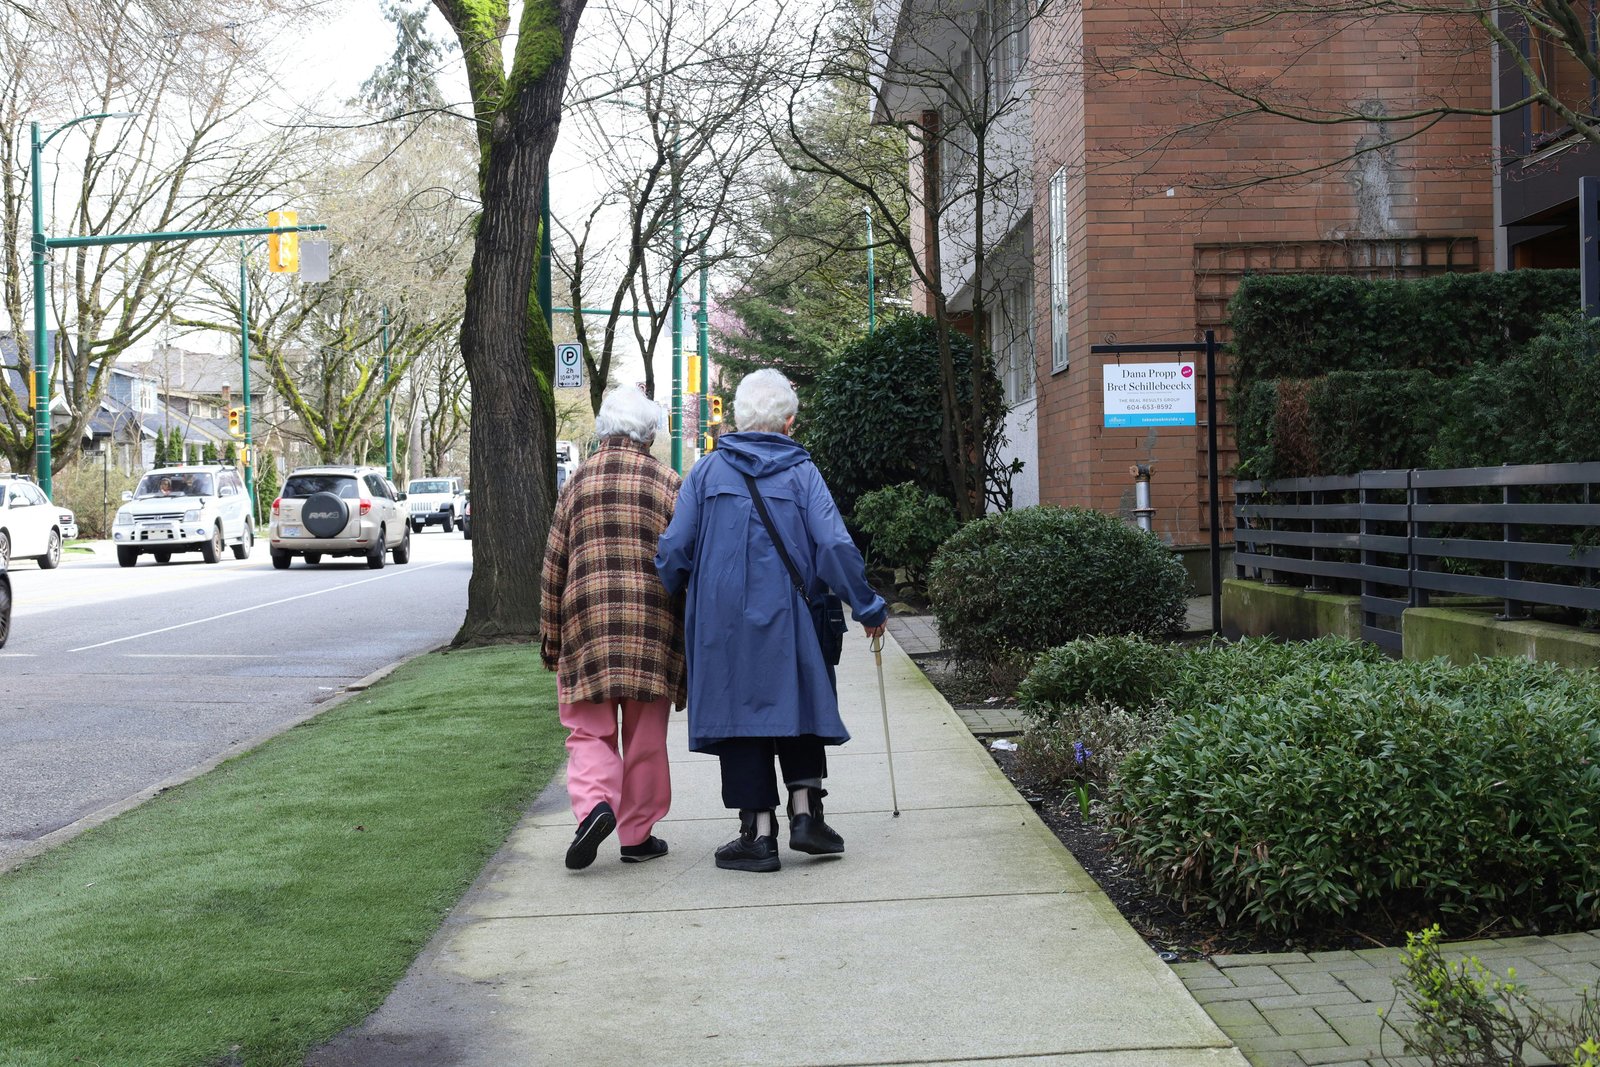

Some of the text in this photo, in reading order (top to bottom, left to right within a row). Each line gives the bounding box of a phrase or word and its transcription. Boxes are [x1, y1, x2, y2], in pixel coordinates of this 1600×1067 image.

[566, 351, 575, 362] P
[1122, 369, 1176, 379] Dana Propp
[1107, 381, 1192, 392] Bret Schillebeeckx
